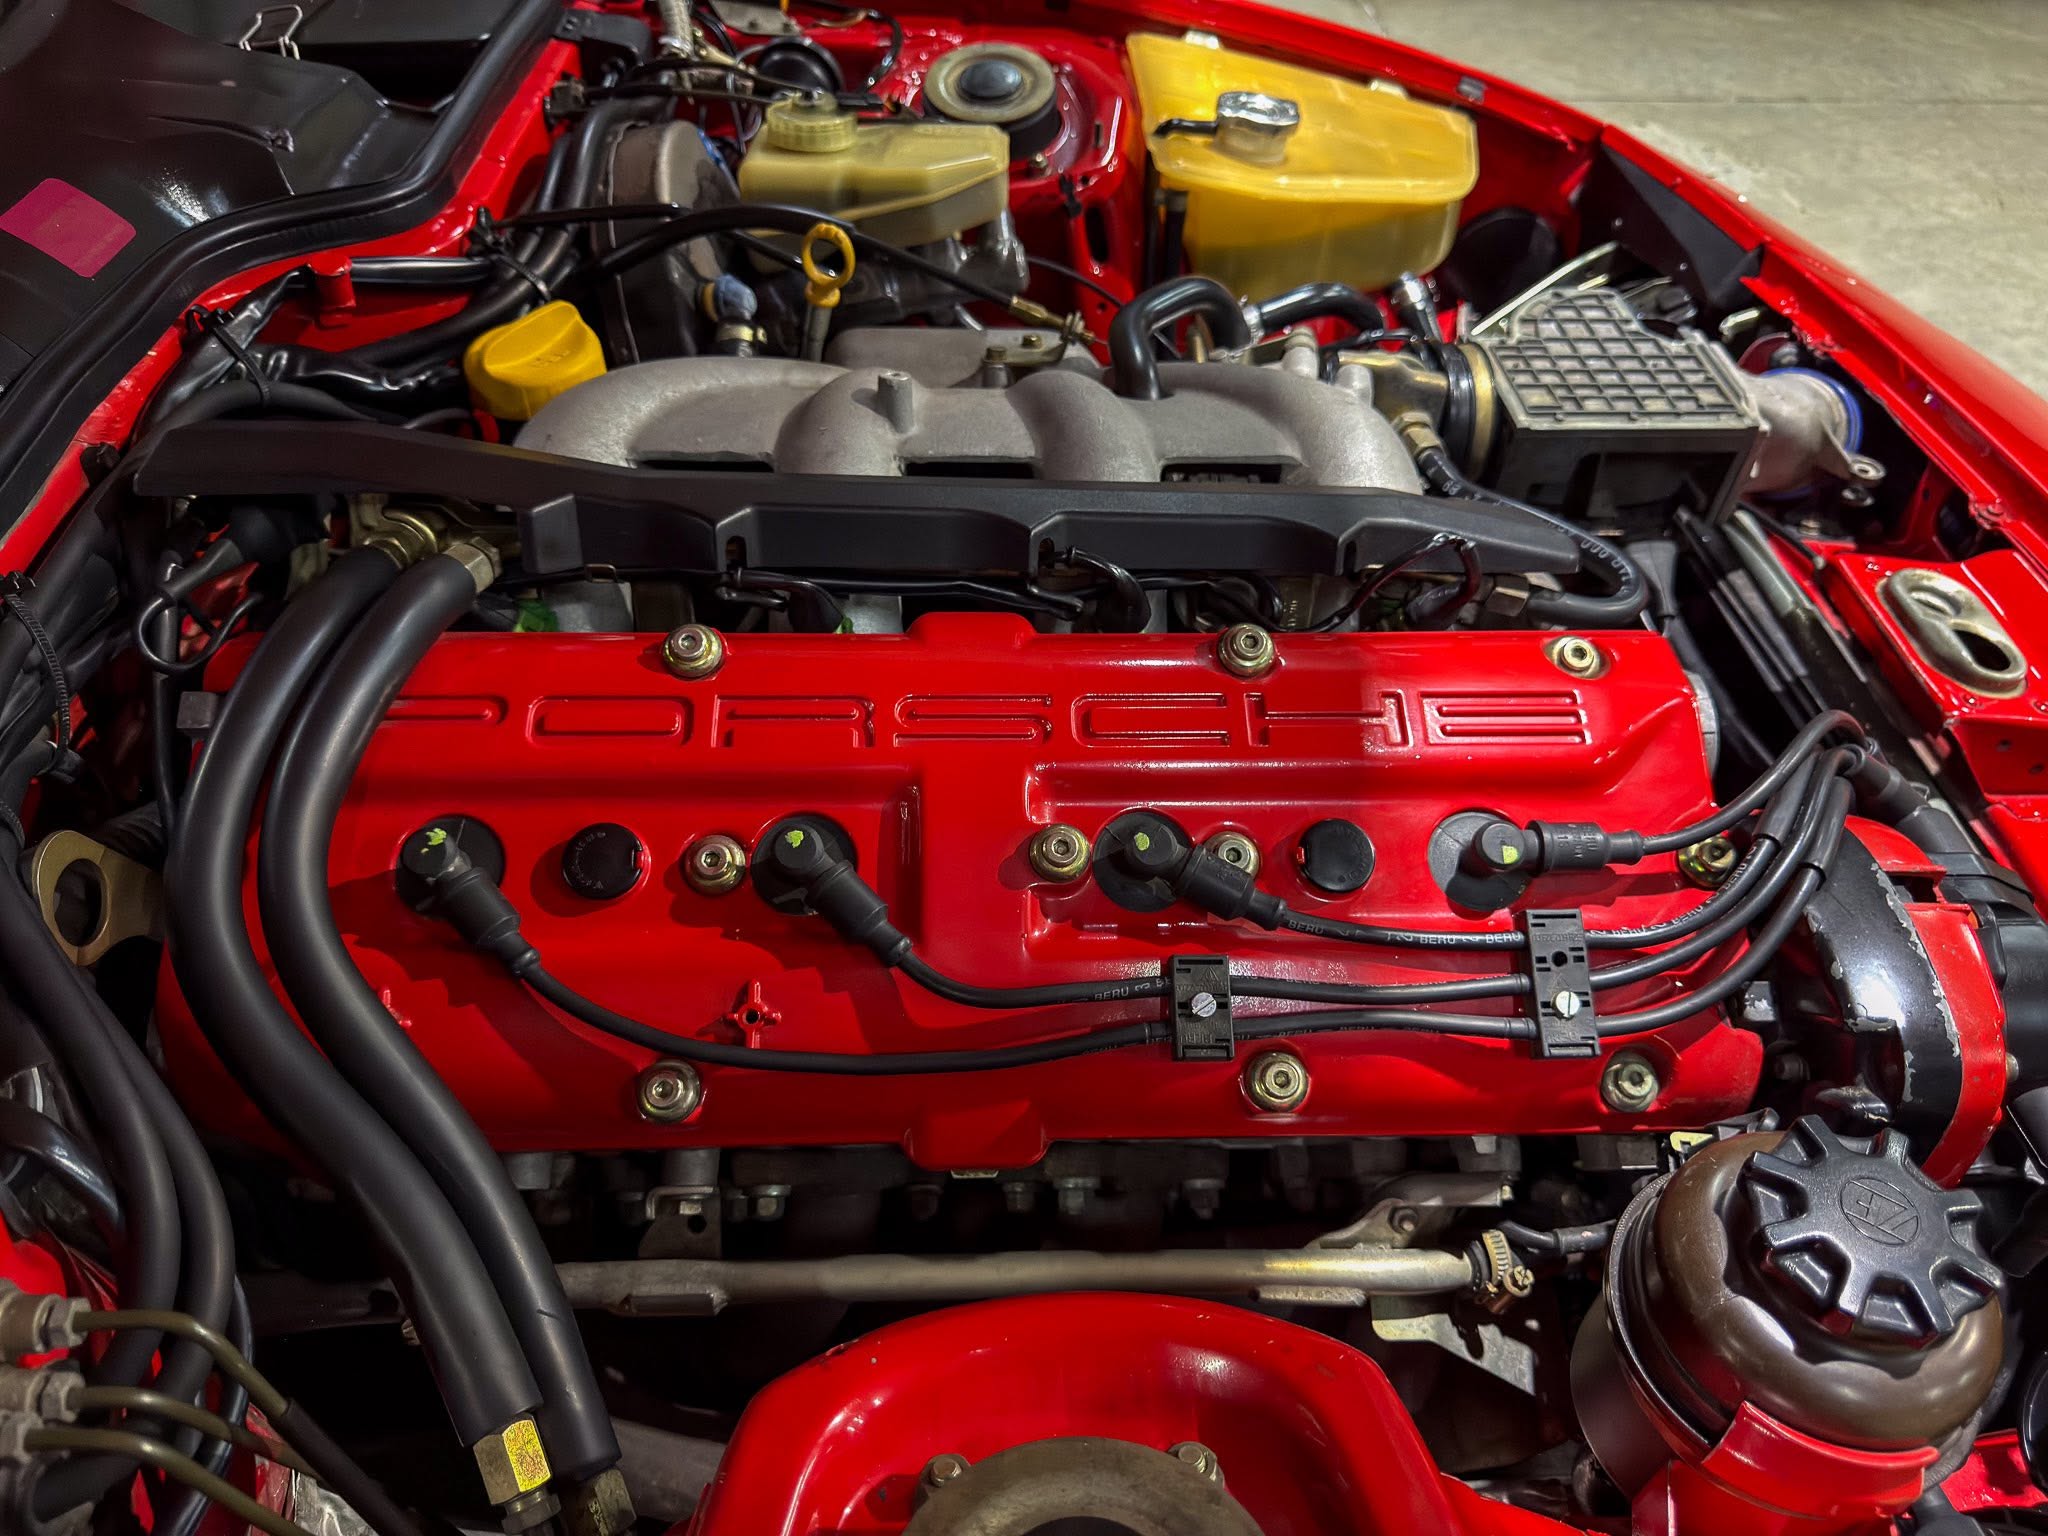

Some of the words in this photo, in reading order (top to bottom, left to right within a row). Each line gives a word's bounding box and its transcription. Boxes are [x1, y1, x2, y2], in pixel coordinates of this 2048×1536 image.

[1288, 919, 1325, 935] BERU
[1420, 934, 1456, 945] BERU
[1485, 933, 1521, 944] BERU
[1094, 986, 1129, 1001] BERU
